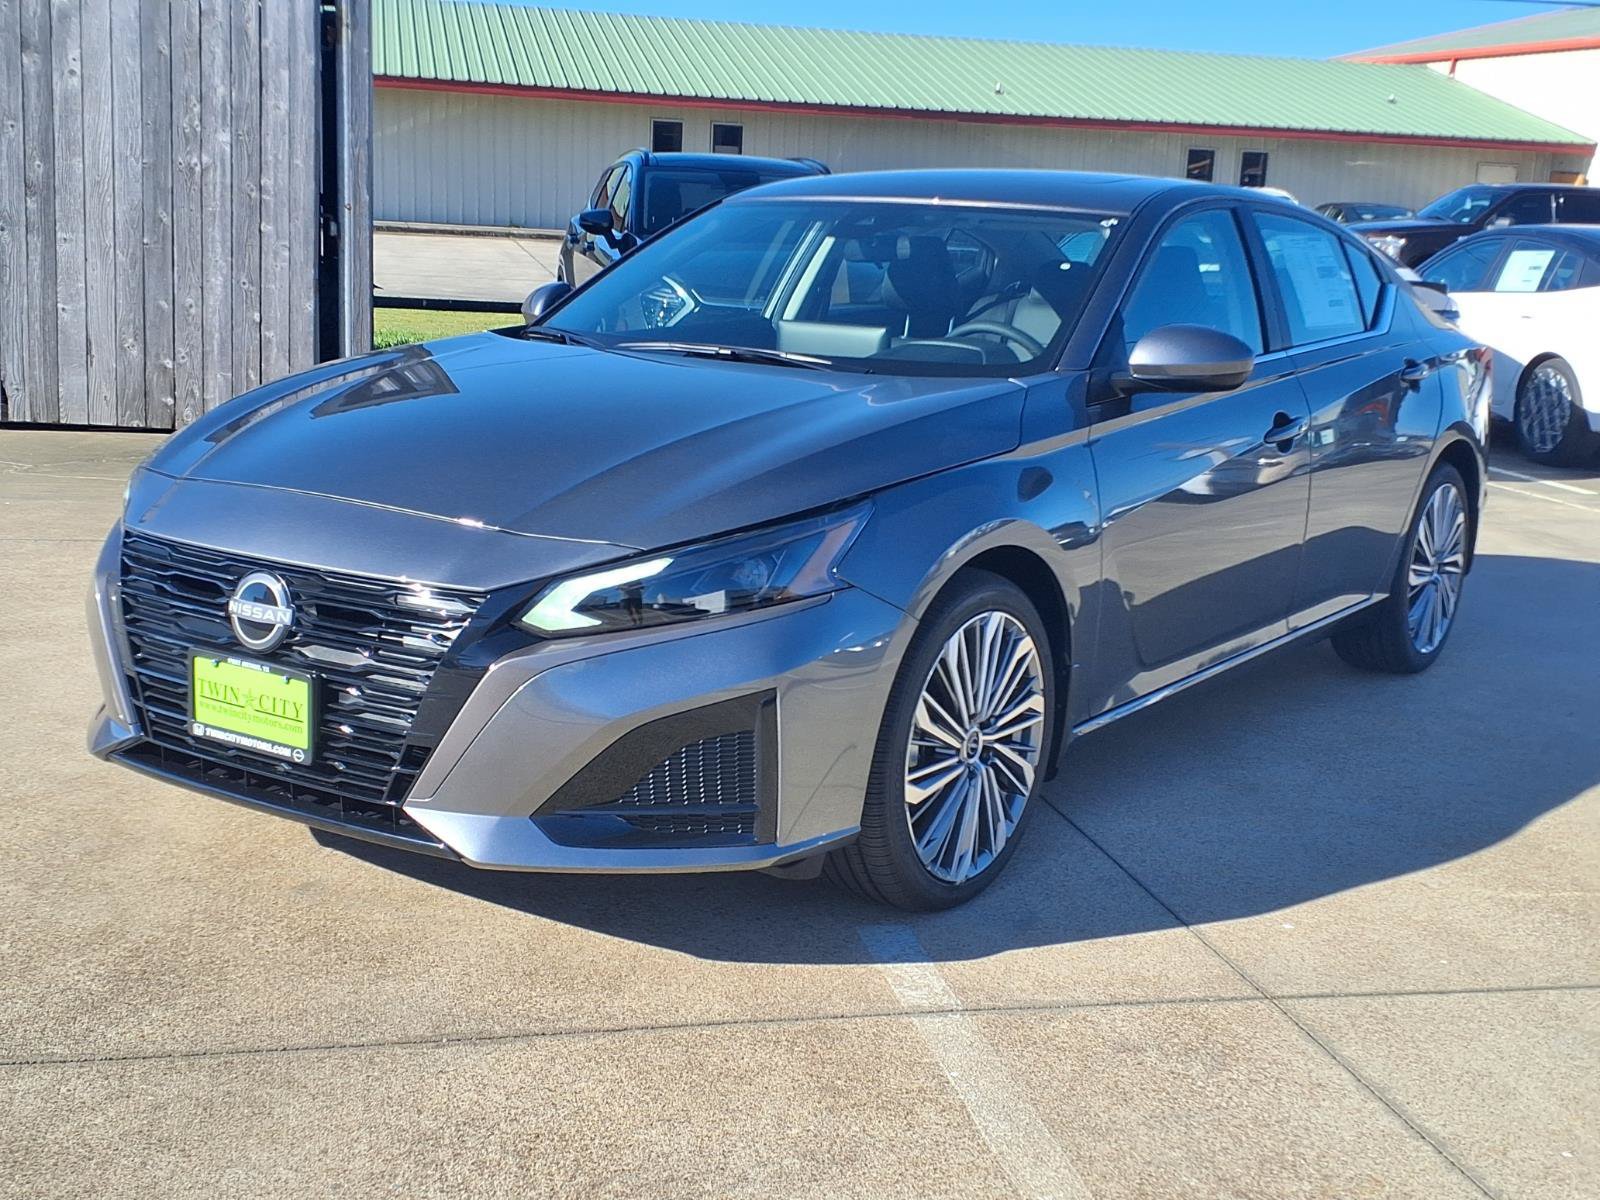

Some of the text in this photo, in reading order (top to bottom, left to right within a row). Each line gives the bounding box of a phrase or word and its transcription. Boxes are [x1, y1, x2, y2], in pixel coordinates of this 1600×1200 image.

[229, 600, 291, 623] NISSAN
[198, 678, 303, 718] TWIN CITY
